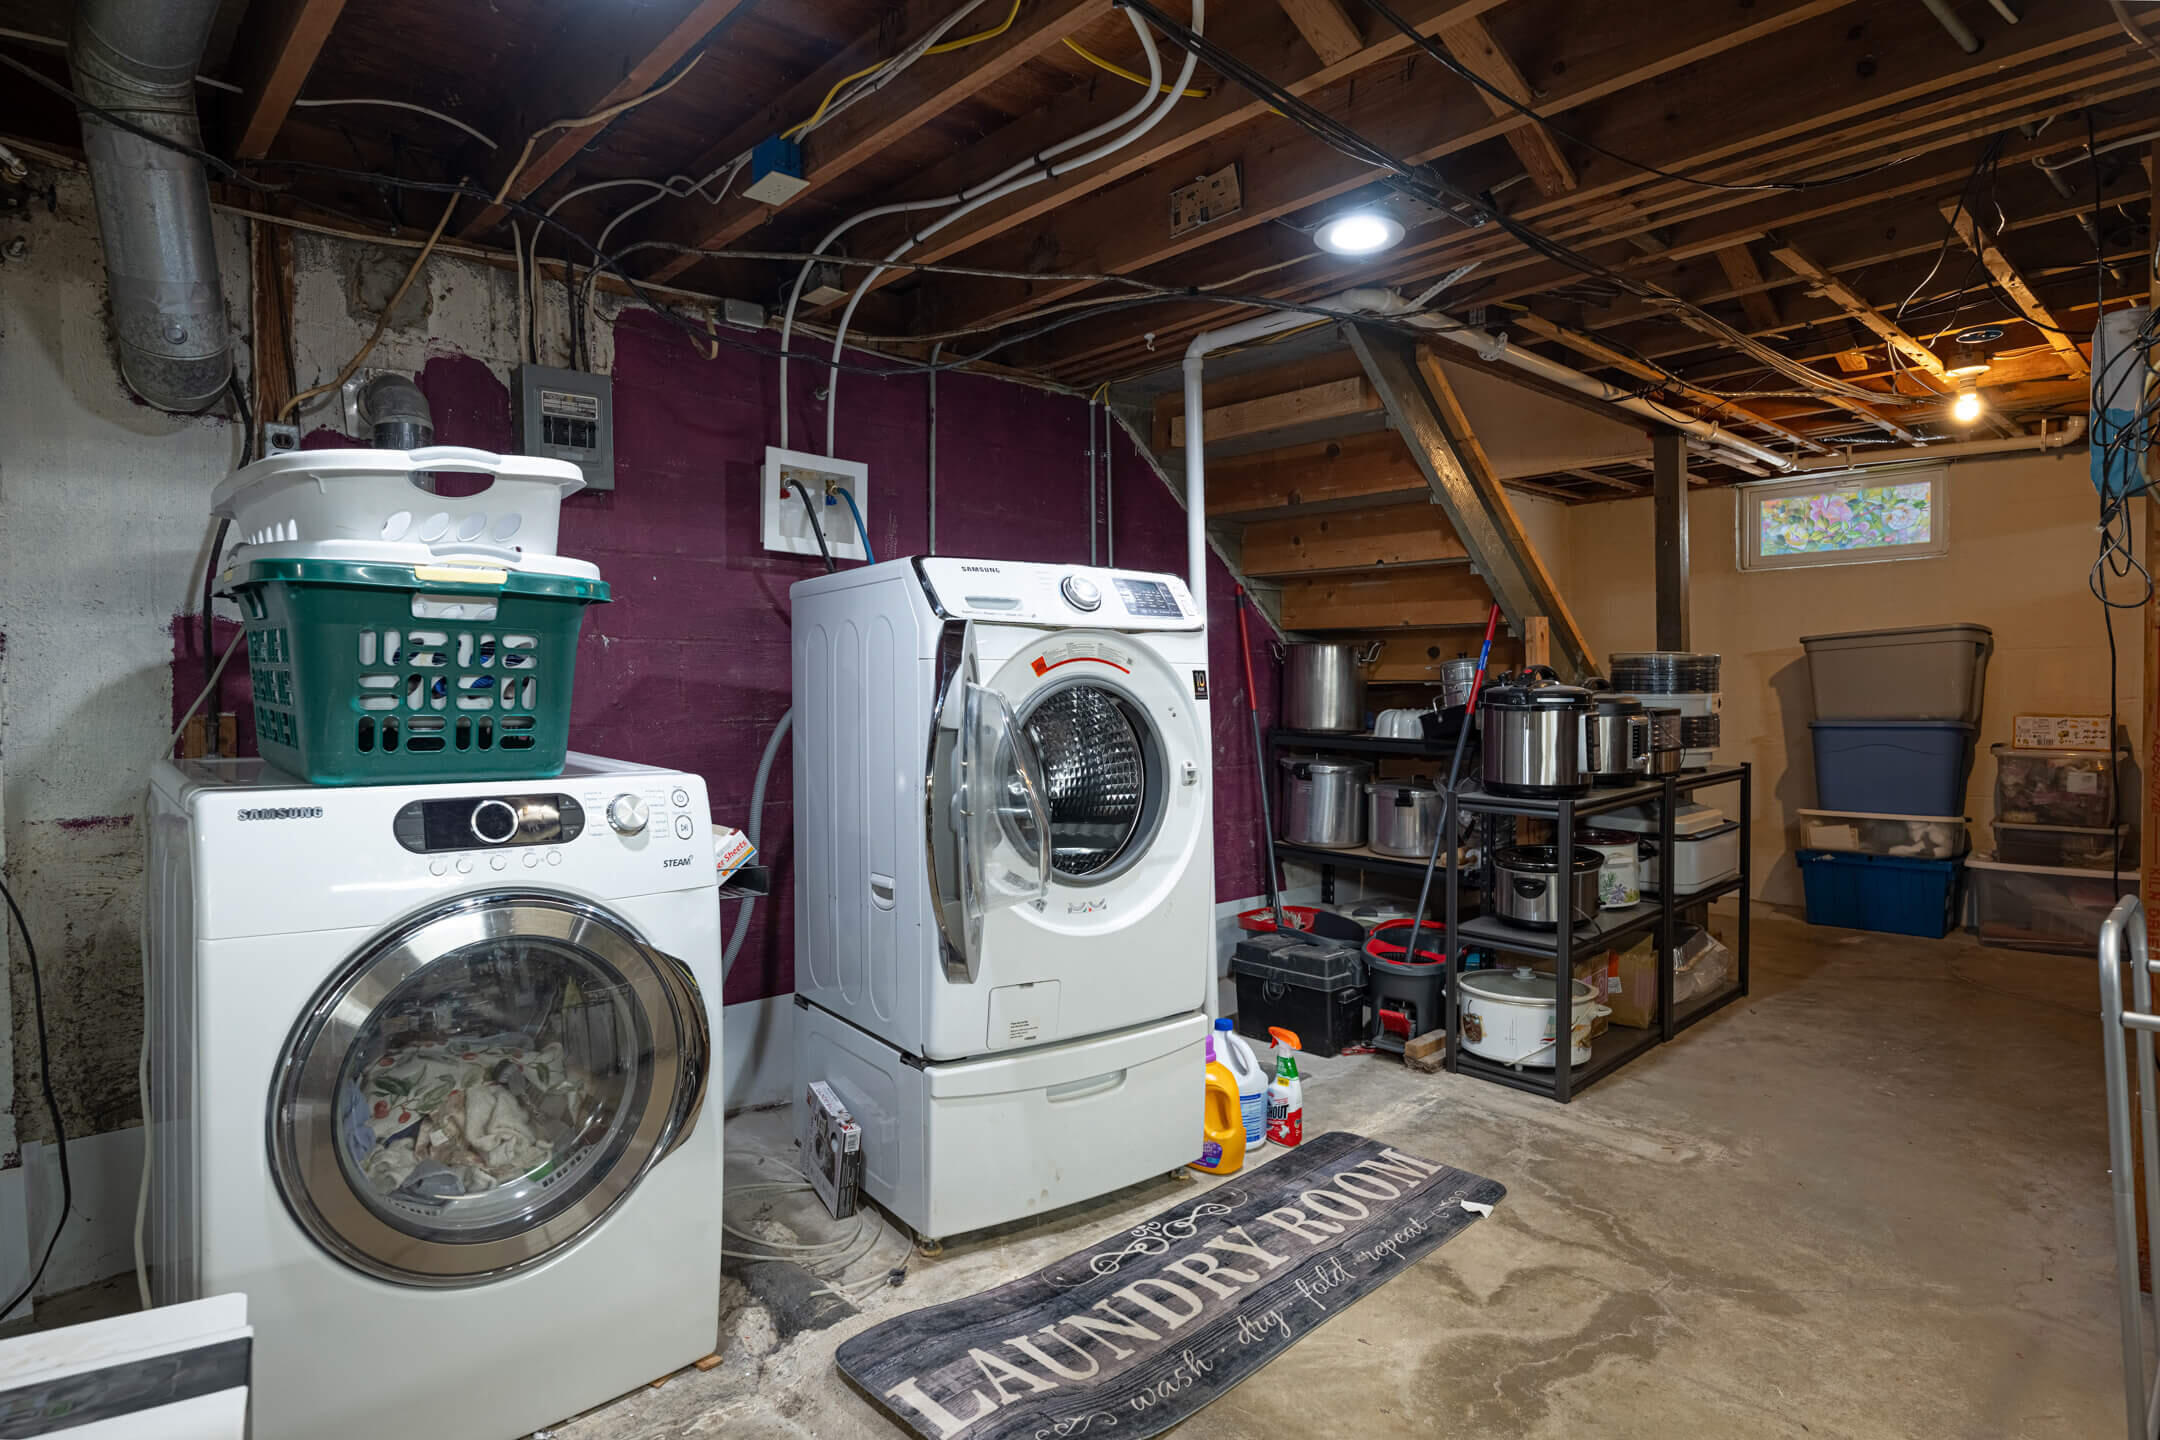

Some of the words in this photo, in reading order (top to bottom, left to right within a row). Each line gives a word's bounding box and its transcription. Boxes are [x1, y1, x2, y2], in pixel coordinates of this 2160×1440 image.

[961, 566, 1000, 574] SAMSUNG
[238, 806, 323, 821] SAMSUNG
[723, 840, 748, 862] Sheets
[663, 858, 691, 868] STEAM
[884, 1226, 1291, 1440] LAUNDRY
[1256, 1147, 1443, 1245] ROOM
[1130, 1349, 1214, 1411] wash
[1238, 1310, 1292, 1345] dry
[1295, 1256, 1357, 1311] fold
[1357, 1217, 1428, 1260] repeat
